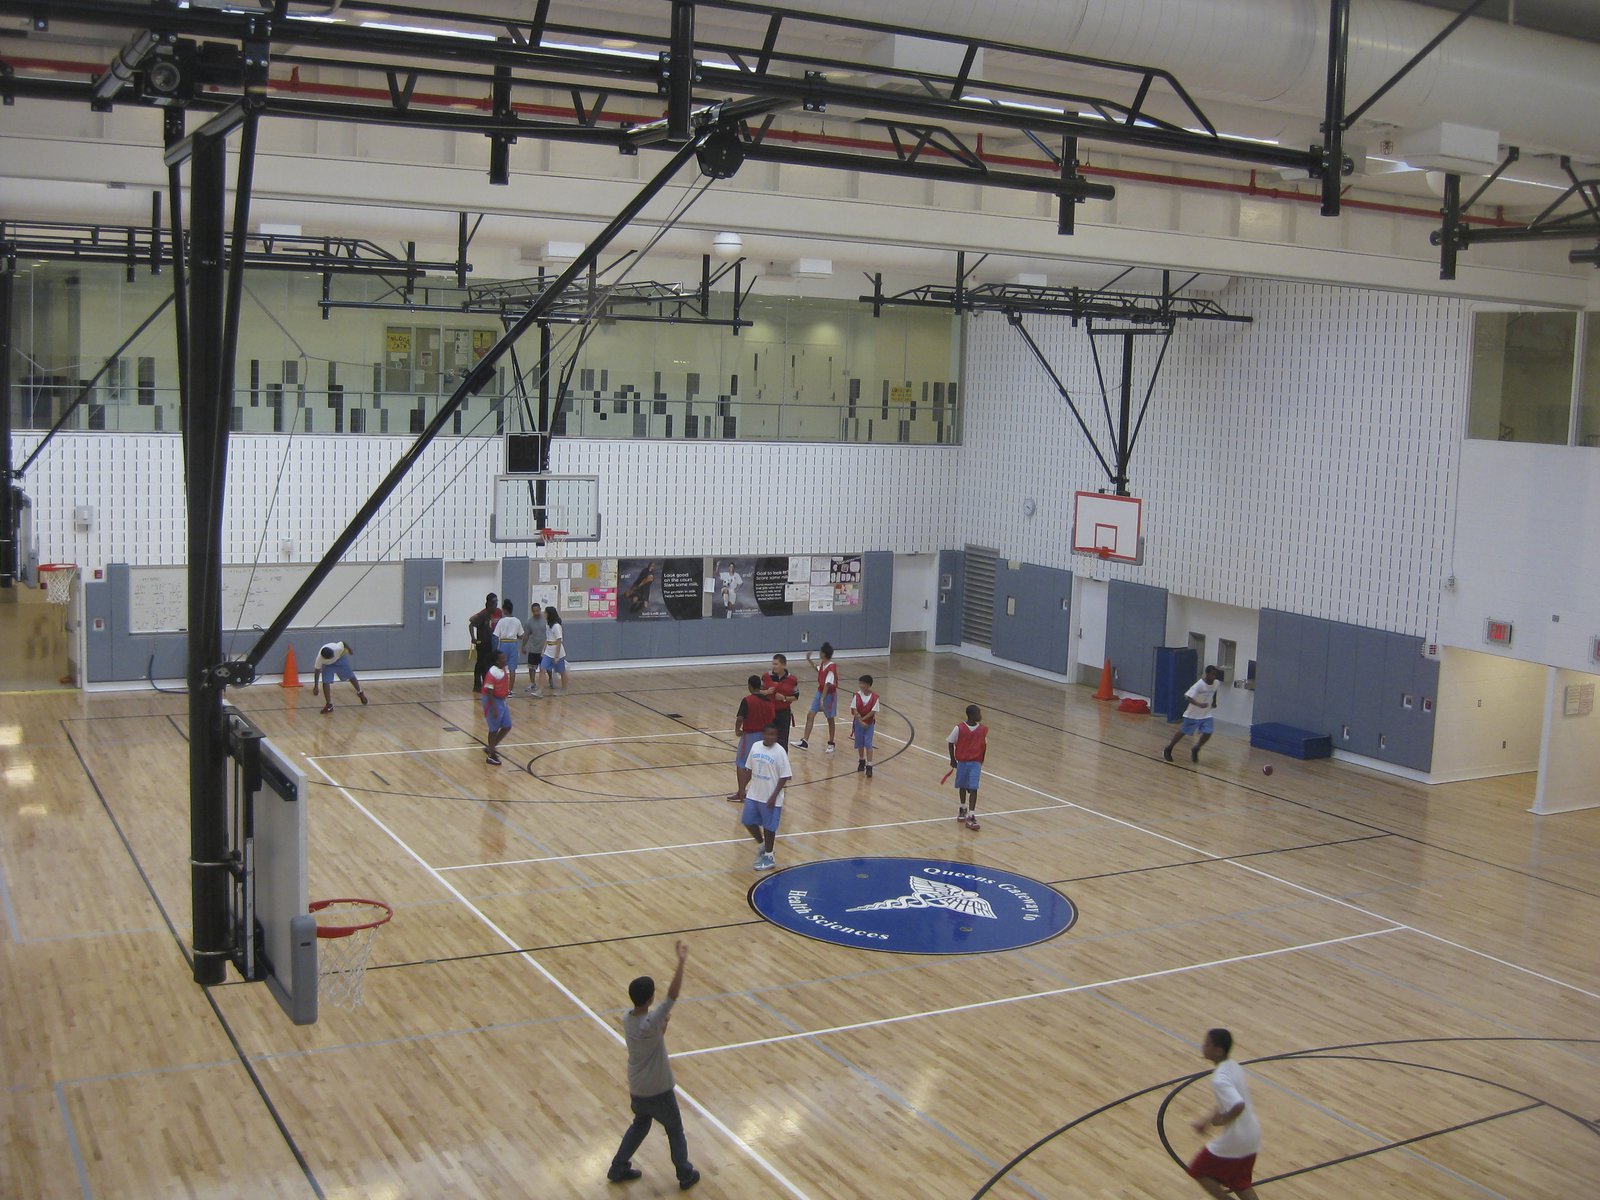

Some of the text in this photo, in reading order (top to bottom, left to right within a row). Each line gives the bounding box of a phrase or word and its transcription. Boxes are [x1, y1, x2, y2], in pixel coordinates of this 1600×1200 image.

[788, 890, 890, 940] Health Sciences
[923, 867, 1040, 921] Queens Gateway to
